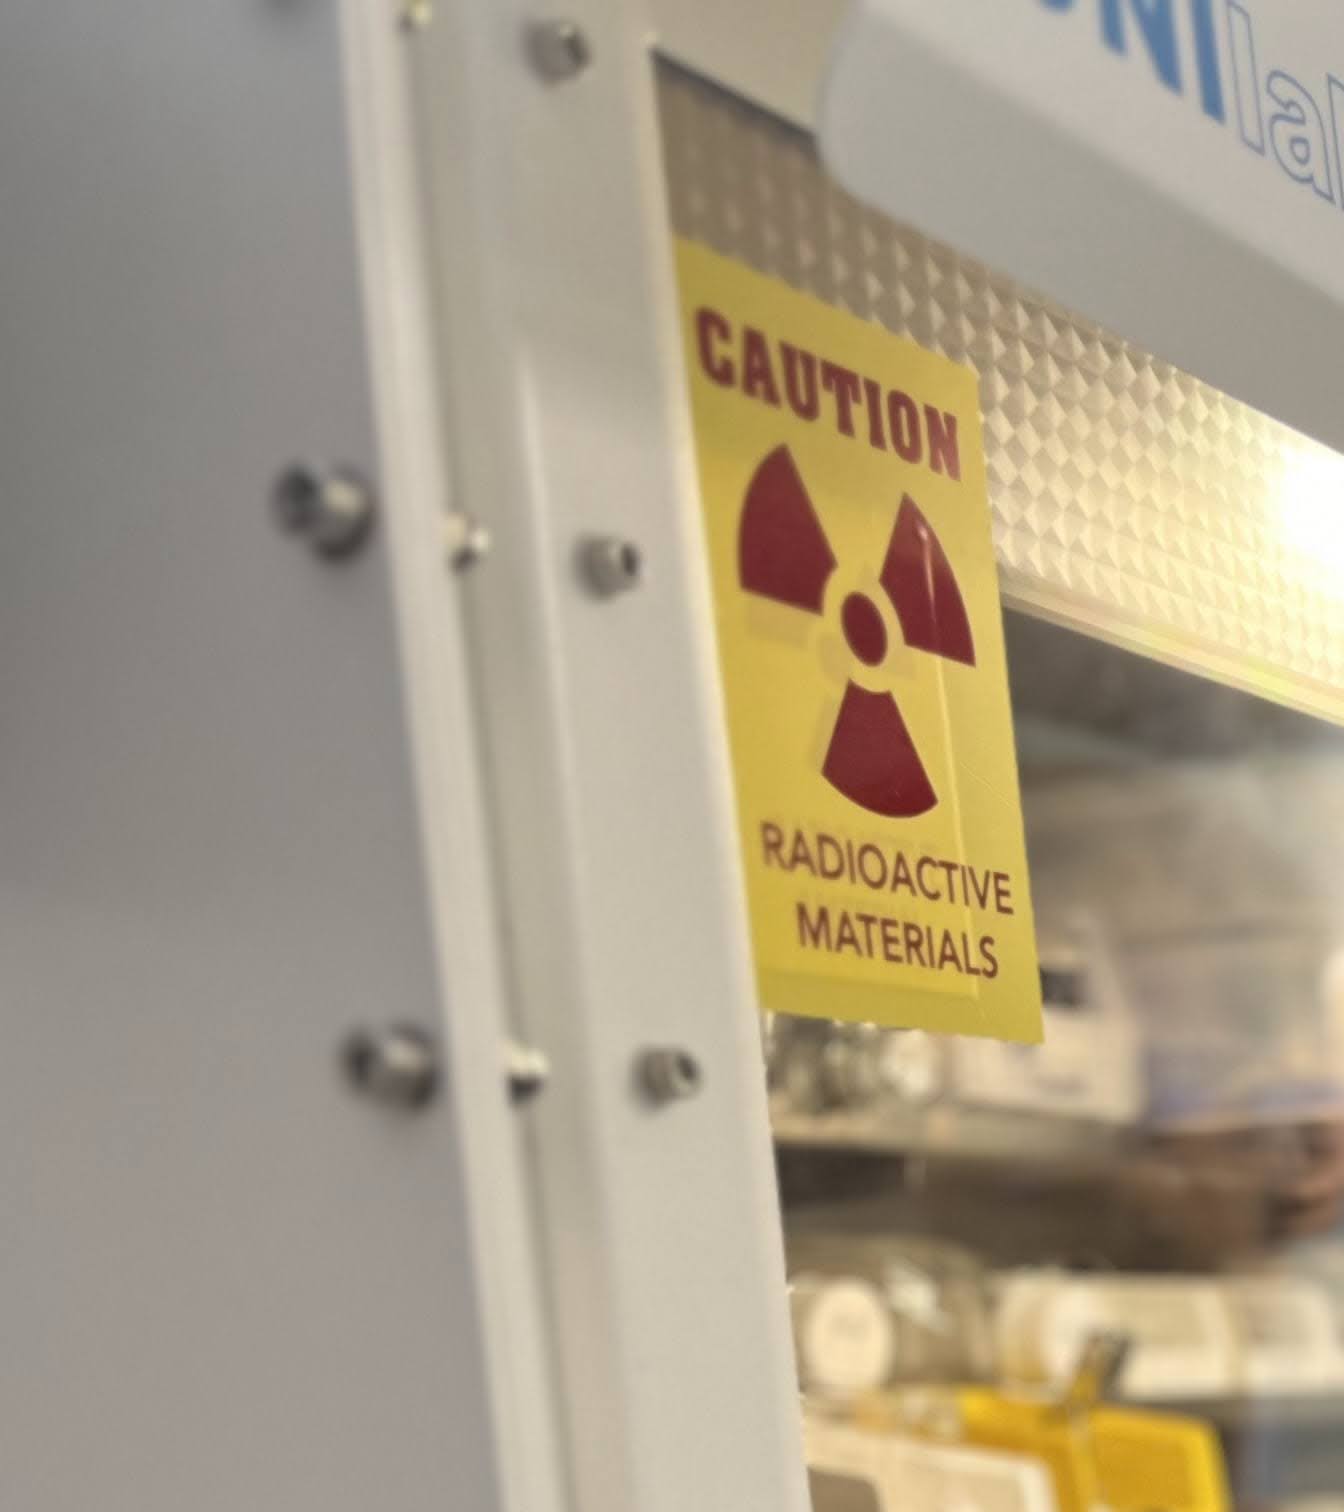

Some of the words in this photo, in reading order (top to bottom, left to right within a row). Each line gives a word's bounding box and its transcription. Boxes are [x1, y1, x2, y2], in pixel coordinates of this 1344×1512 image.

[695, 306, 962, 482] CAUTION
[760, 820, 1015, 916] RADIOACTIVE
[795, 902, 1000, 980] MATERIALS
